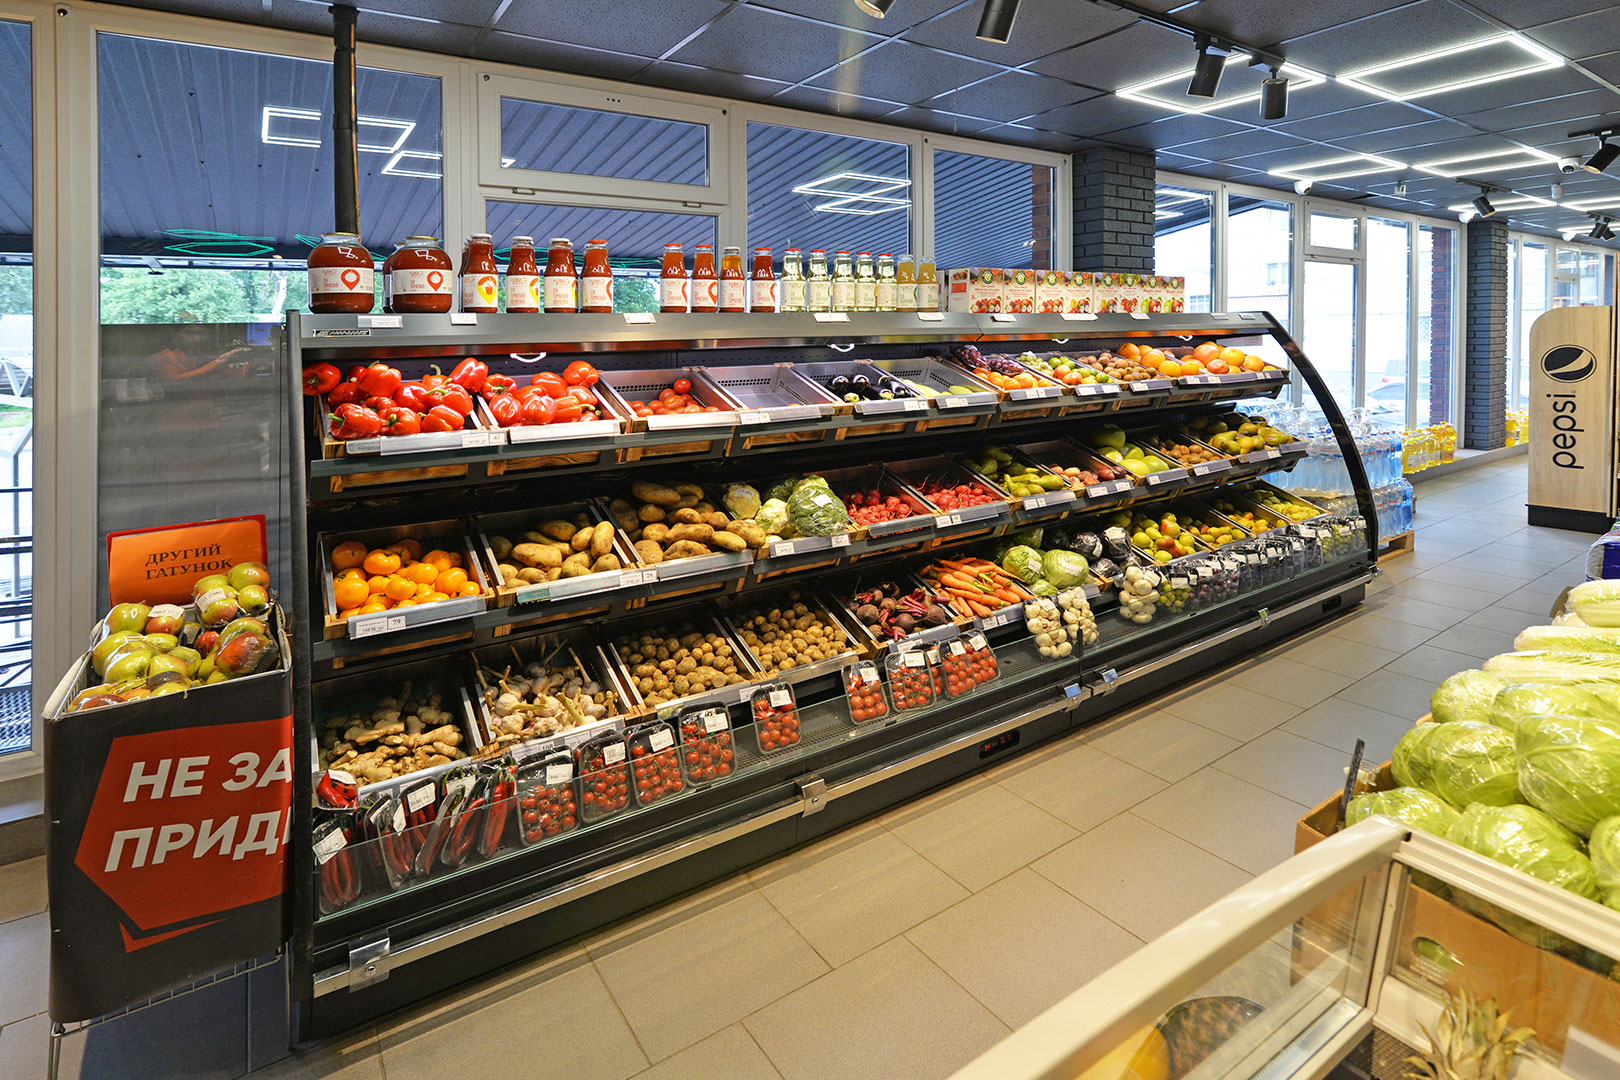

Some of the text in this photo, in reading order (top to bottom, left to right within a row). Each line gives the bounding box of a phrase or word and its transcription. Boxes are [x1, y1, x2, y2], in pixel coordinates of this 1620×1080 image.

[1546, 393, 1584, 469] pepsi
[145, 543, 221, 567] ДРУГИЙ
[146, 558, 233, 579] ГАТУНОК
[123, 747, 292, 803] НЕ ЗА
